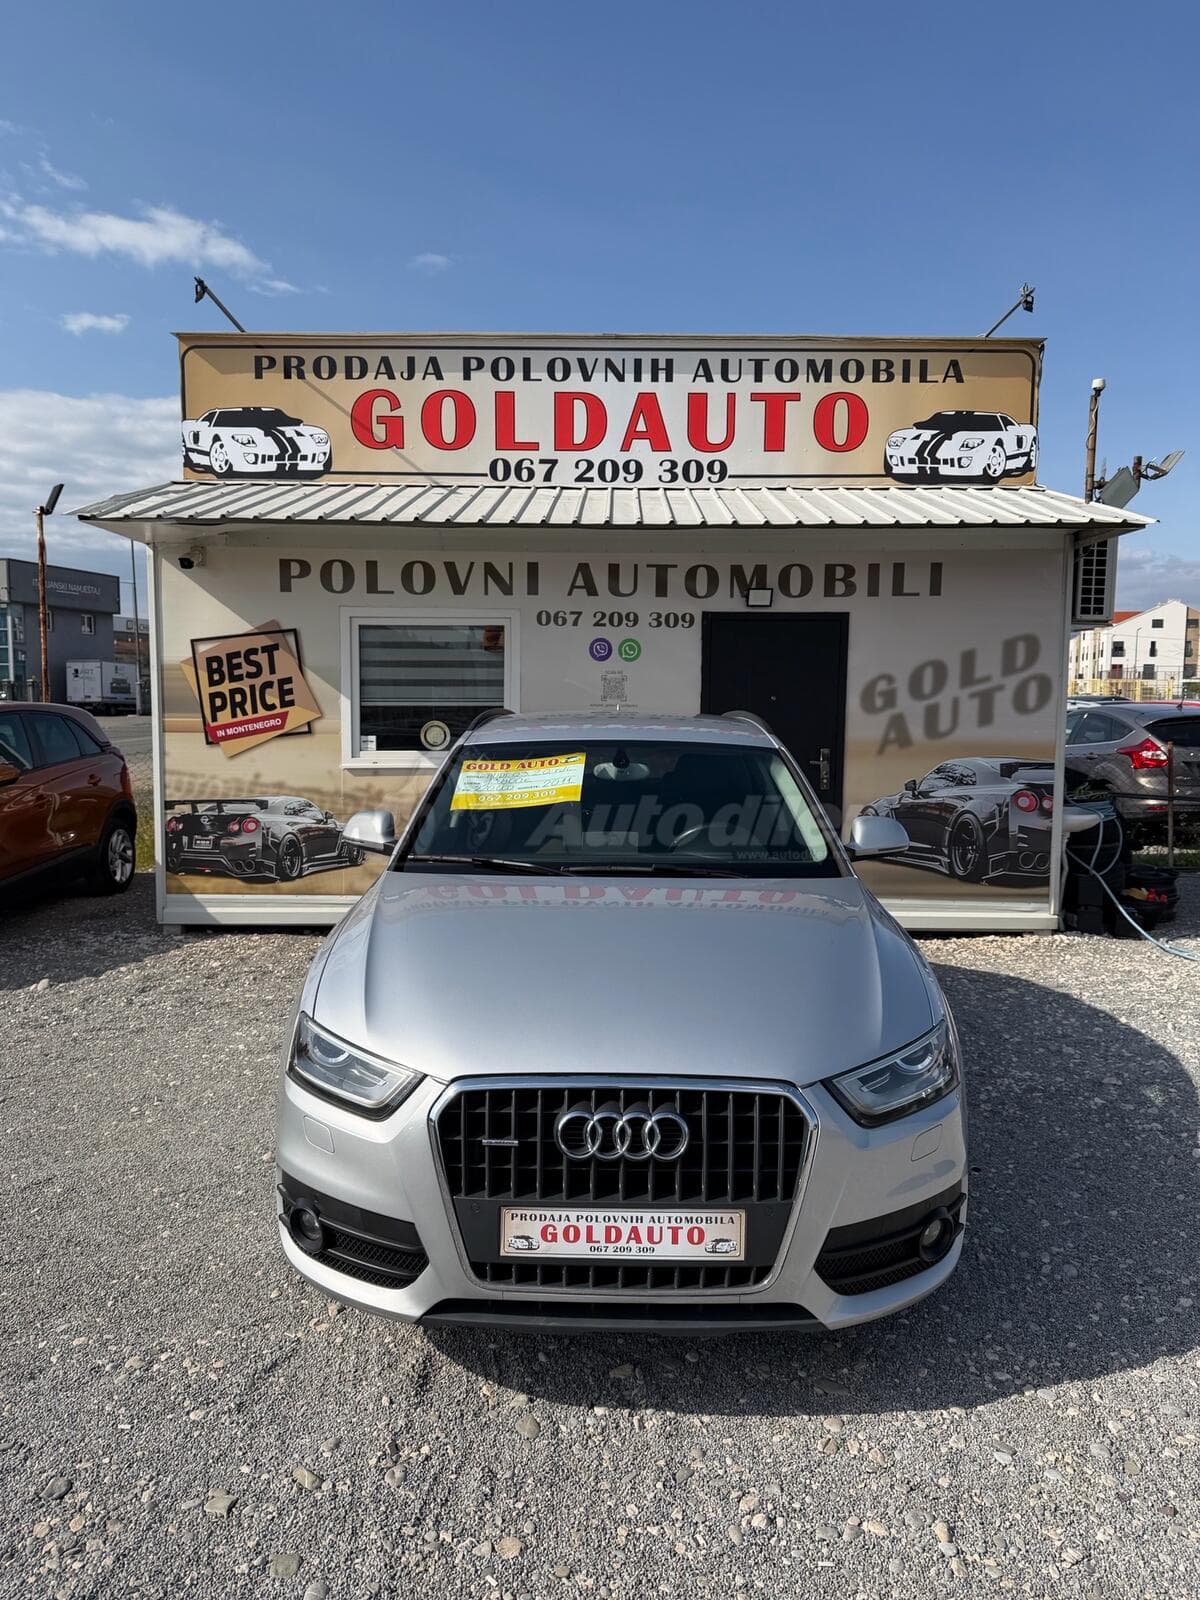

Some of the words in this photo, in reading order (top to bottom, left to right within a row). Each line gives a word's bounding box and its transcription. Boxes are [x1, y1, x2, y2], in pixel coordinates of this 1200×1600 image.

[253, 355, 445, 381] PRODAJA
[462, 356, 674, 383] POLOVNIH
[692, 358, 965, 384] AUTOMOBILA
[350, 388, 870, 453] GOLDAUTO
[488, 457, 559, 483] 067
[574, 458, 644, 484] 209
[657, 459, 729, 484] 309
[278, 558, 541, 596] POLOVNI
[567, 561, 943, 599] AUTOMOBILI
[536, 609, 583, 627] 067
[592, 610, 640, 628] 209
[648, 611, 695, 629] 309
[205, 643, 280, 687] BEST
[859, 633, 1042, 715] GOLD
[208, 677, 296, 723] PRICE
[876, 672, 1054, 755] AUTO
[216, 728, 226, 738] IN
[226, 718, 282, 736] MONTENEGRO
[466, 762, 512, 771] GOLD
[516, 758, 561, 770] AUTO
[478, 794, 502, 802] 067
[510, 1212, 571, 1223] PRODAJA
[576, 1214, 644, 1224] POLOVNIH
[649, 1215, 736, 1225] AUTOMOBILA
[540, 1224, 706, 1245] GOLDAUTO
[589, 1245, 610, 1254] 067
[612, 1246, 632, 1254] 209
[635, 1246, 655, 1255] 309
